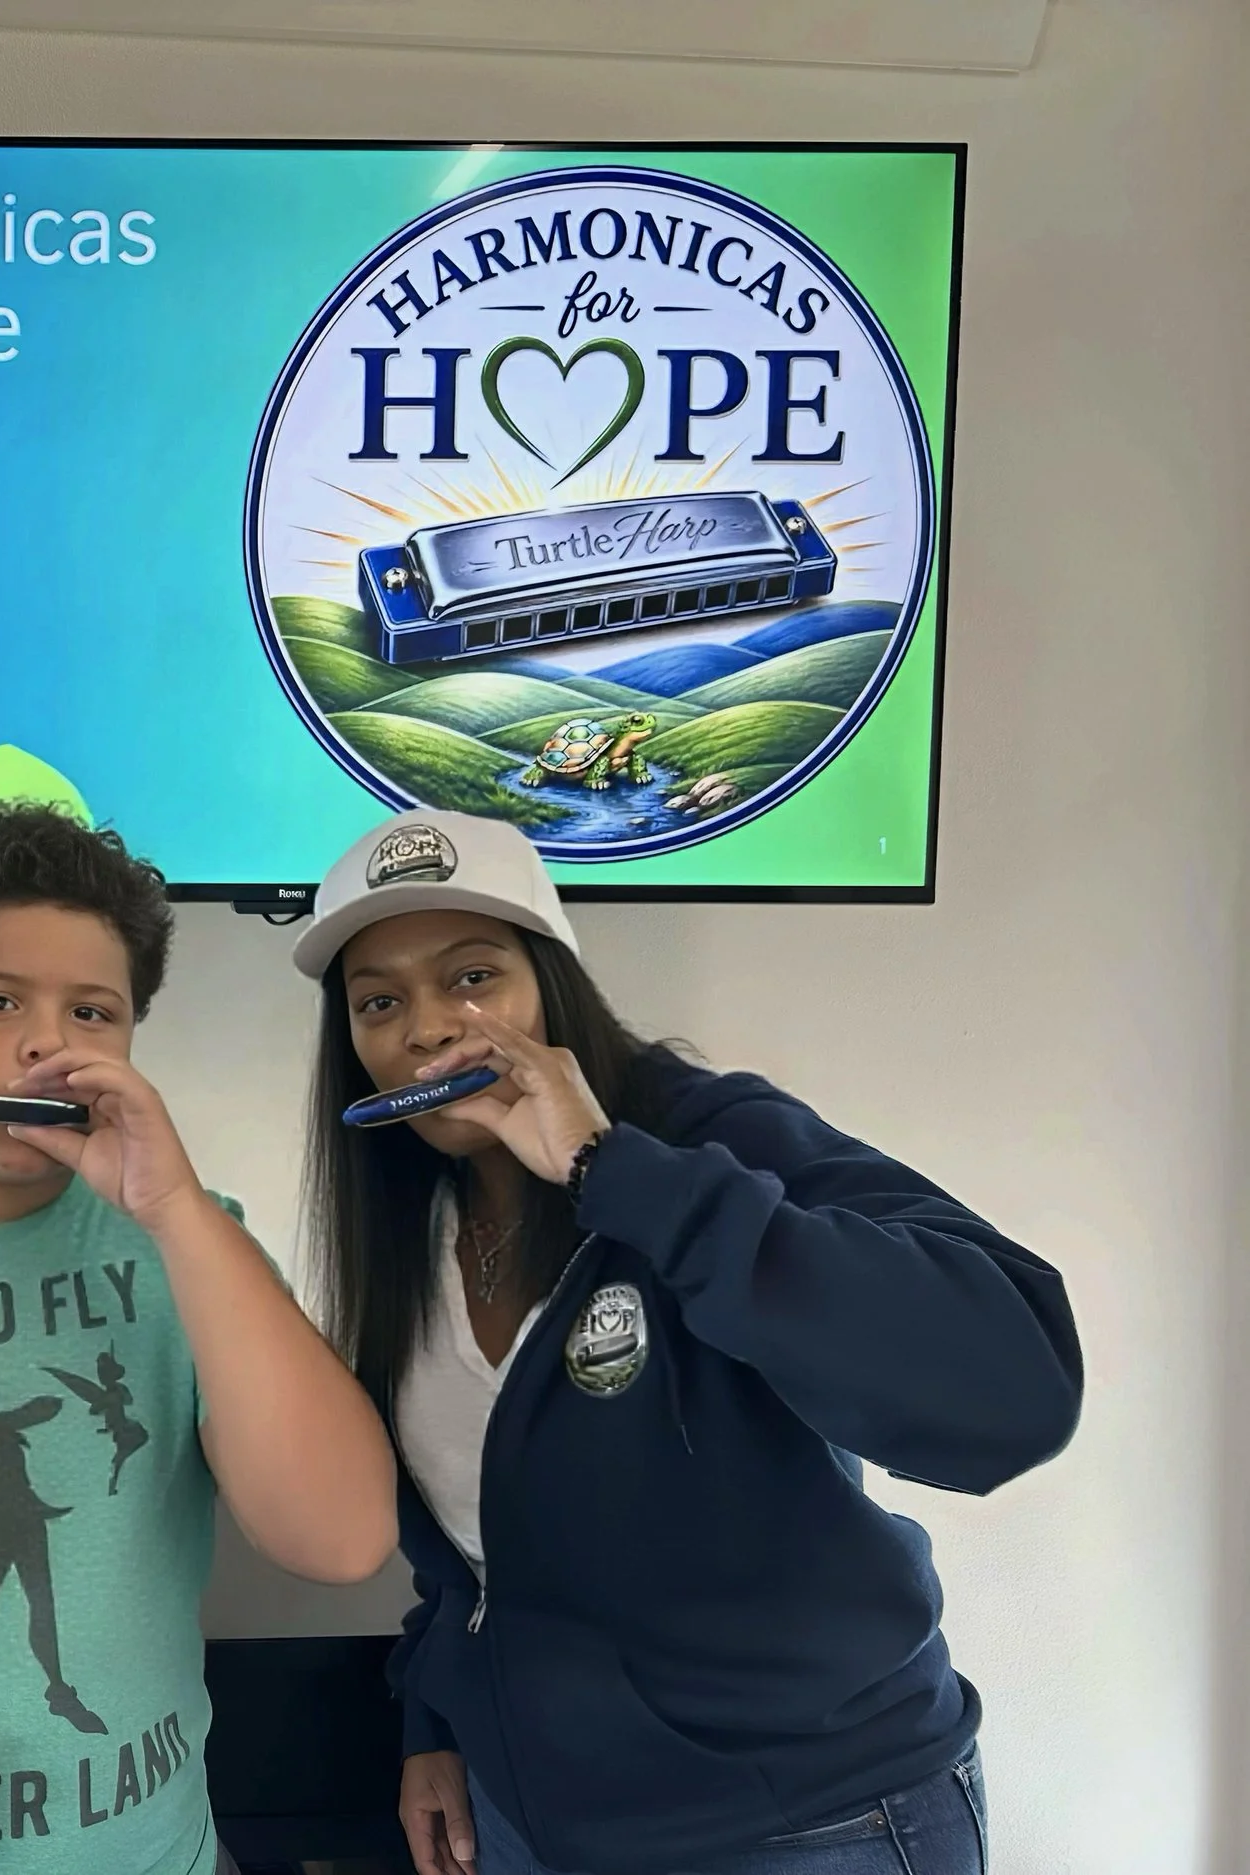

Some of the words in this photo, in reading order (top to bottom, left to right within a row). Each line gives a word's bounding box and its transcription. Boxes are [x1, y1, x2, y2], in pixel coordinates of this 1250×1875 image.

[366, 206, 831, 339] HARMONICAS
[558, 270, 642, 339] for
[879, 836, 887, 855] 1
[40, 1259, 137, 1336] FLY
[79, 1711, 191, 1828] LAND
